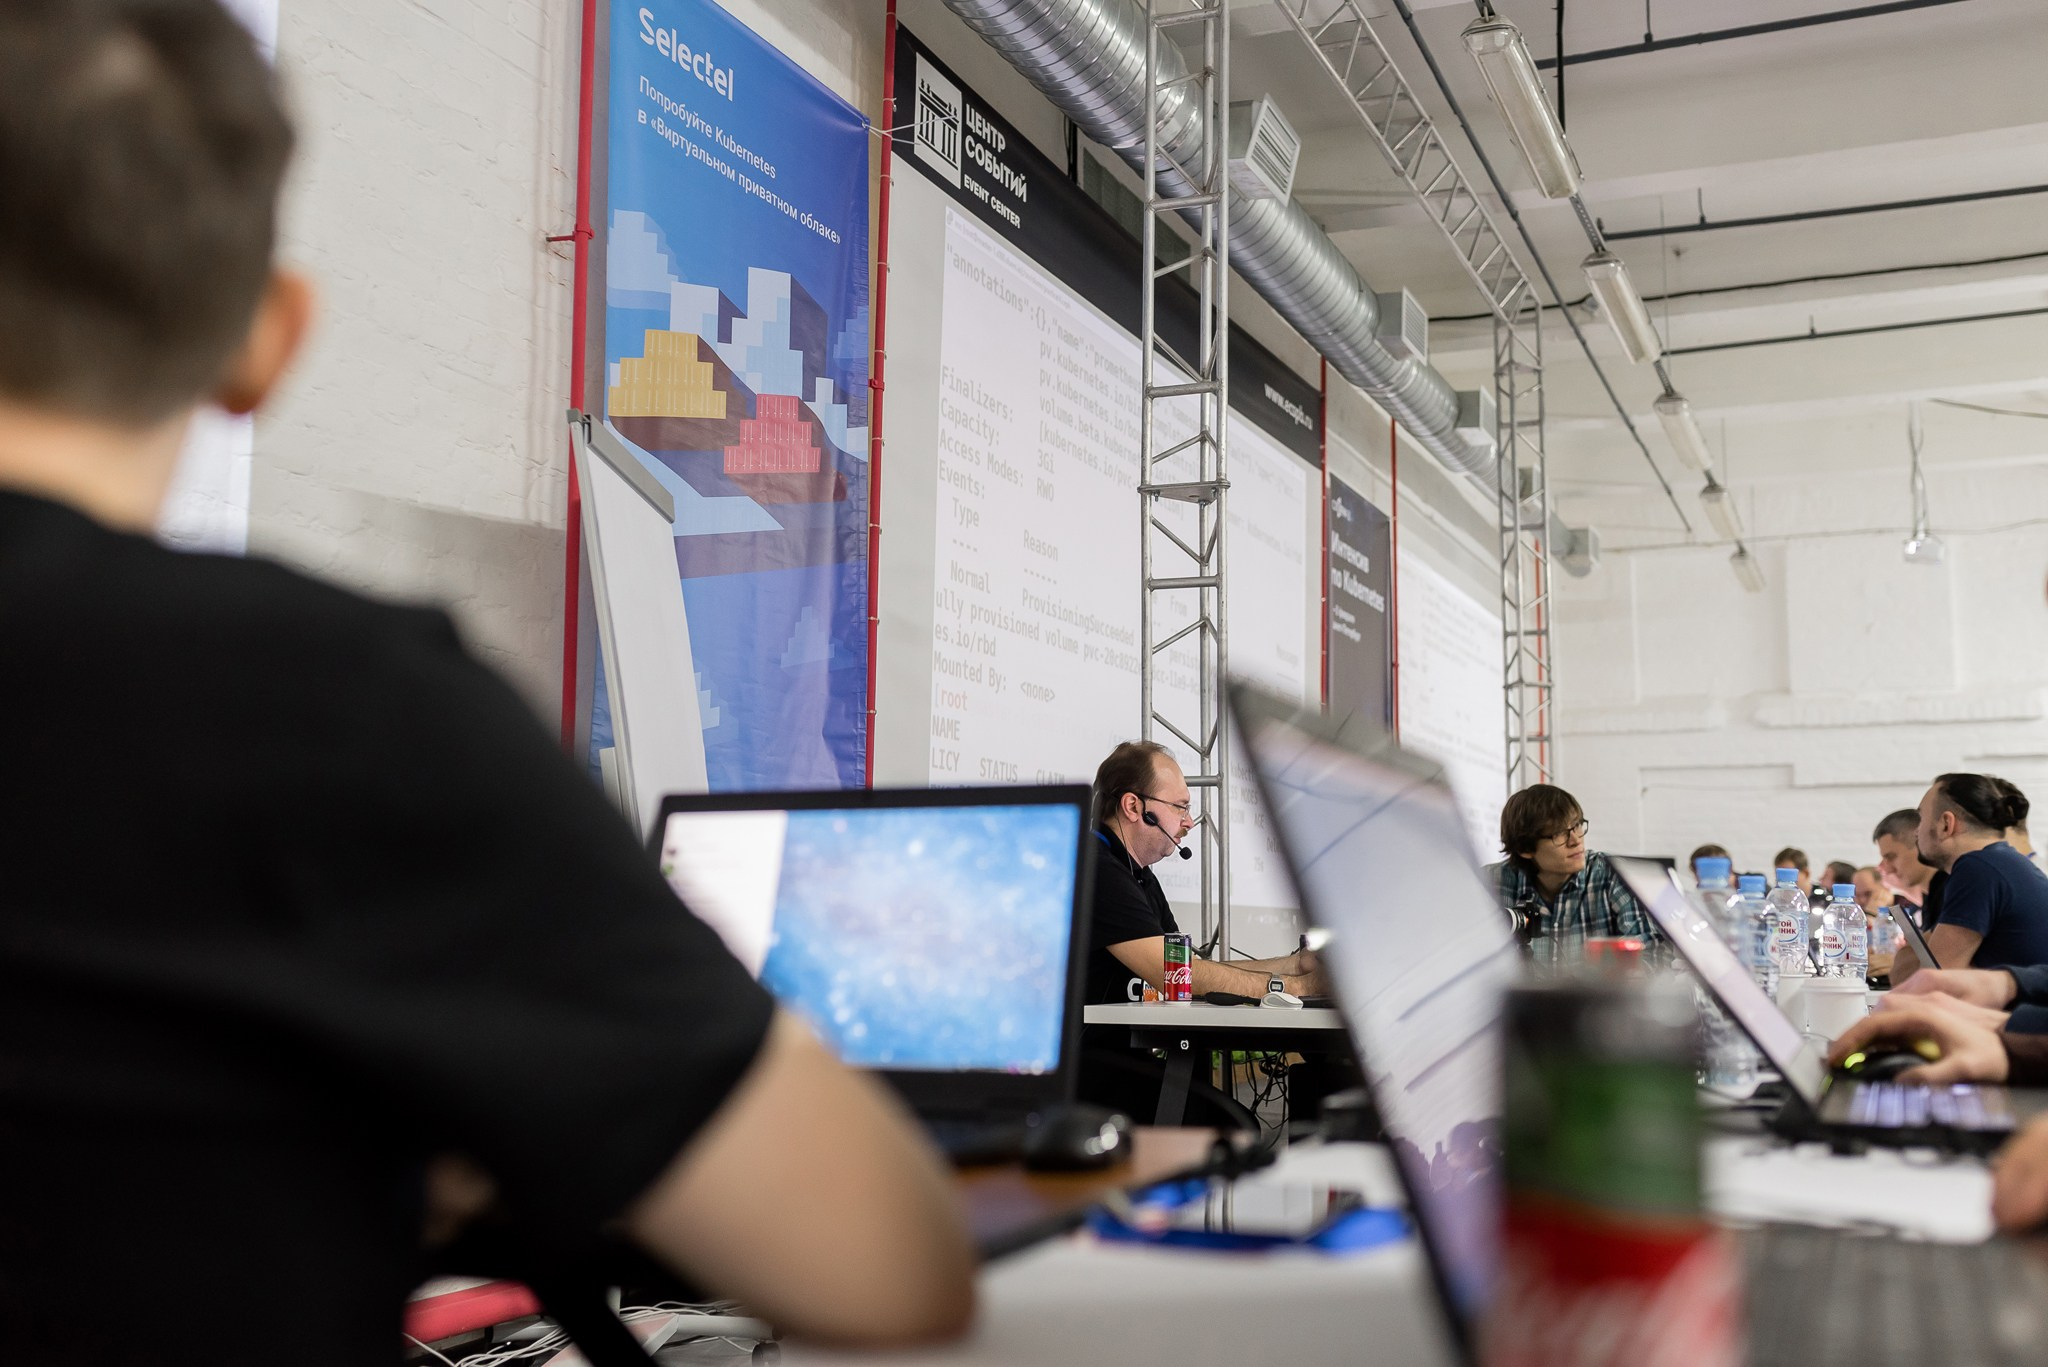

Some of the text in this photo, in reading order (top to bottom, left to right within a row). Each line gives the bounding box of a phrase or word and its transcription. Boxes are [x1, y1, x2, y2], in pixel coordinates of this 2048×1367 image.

[639, 7, 734, 101] Selectel
[640, 75, 776, 179] Попробуйте Kubernetes
[966, 103, 1006, 152] ЦЕНТР
[637, 108, 841, 245] в «Виртуальном приватном облаке»
[965, 134, 1027, 203] СОБЫТИЙ
[964, 174, 1021, 229] EVENT CENTER
[942, 365, 1013, 422] Finalizers:
[941, 397, 1055, 474] Capacity: 3Gi
[938, 461, 985, 500] Events:
[939, 428, 1055, 502] Access Modes: RWO
[952, 497, 980, 528] Type
[1023, 529, 1059, 562] Reason
[950, 560, 992, 594] Normal
[1022, 588, 1135, 647] ProvisioningSucceeded
[970, 603, 1040, 642] provisioned
[1045, 628, 1079, 655] volume
[935, 624, 996, 657] es.io/rbd
[934, 651, 1056, 703] Mounted By: <none>
[932, 715, 960, 742] NAME
[931, 747, 960, 773] LICY
[979, 757, 1018, 783] STATUS
